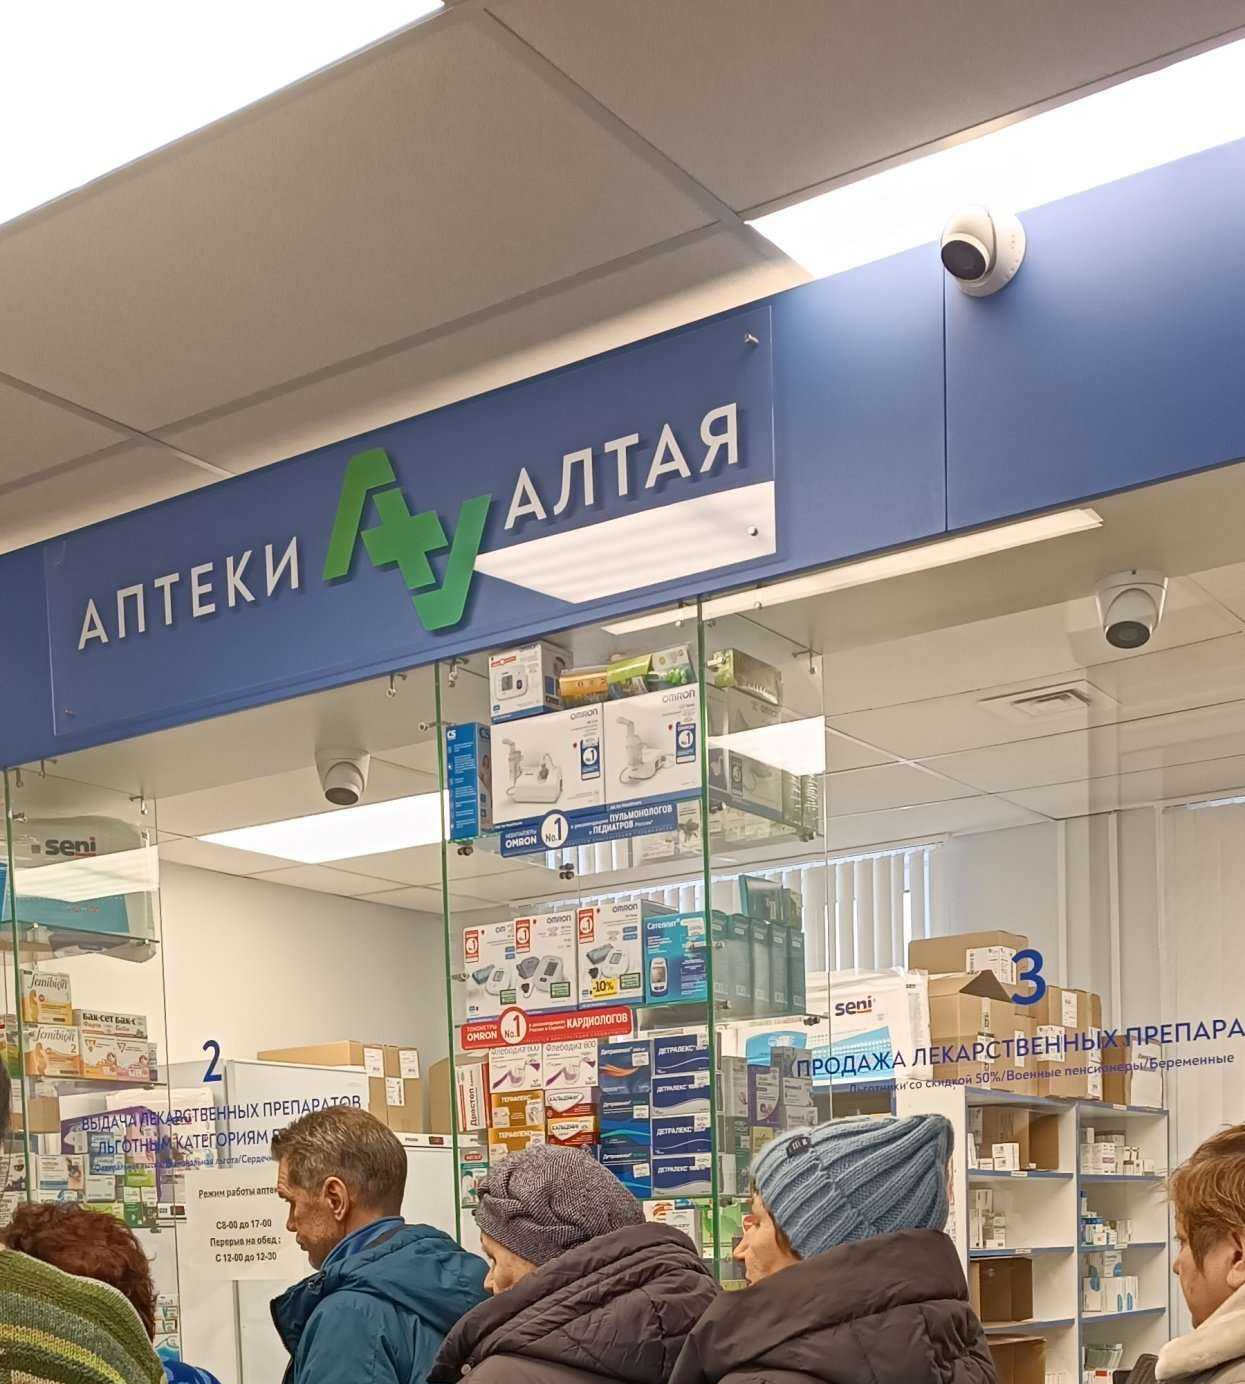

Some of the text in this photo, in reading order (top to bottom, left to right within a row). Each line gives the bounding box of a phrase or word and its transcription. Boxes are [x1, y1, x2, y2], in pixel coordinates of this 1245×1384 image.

[77, 402, 740, 651] АПТЕКИ АЛТАЯ
[609, 804, 673, 823] ПУЛЬМОНОЛОГОВ
[593, 820, 634, 835] ПЕДИАТРОВ
[45, 836, 97, 857] seni
[505, 835, 537, 849] OMRON
[1011, 949, 1047, 1006] 3
[593, 980, 614, 992] -10%
[835, 995, 873, 1017] seni
[567, 1012, 628, 1029] КАРДИОЛОГОВ
[467, 1031, 498, 1042] OMRON
[71, 1043, 77, 1053] 2
[797, 1050, 906, 1078] ПРОДАЖА
[912, 1029, 1118, 1067] ЛЕКАРСТВЕННЫХ
[202, 1039, 222, 1082] 2
[926, 1076, 972, 1089] скидкой
[82, 1095, 361, 1132] ВЫДАЧА ЛЕКАРСТВЕННЫХ ПРЕПАРАТОВ
[98, 1136, 172, 1154] ЛЬГОТНЫМ
[176, 1130, 269, 1151] КАТЕГОРИЯМ
[198, 1189, 225, 1199] Режим
[226, 1187, 255, 1198] работы
[239, 1221, 250, 1230] до
[251, 1219, 272, 1229] 17-00
[210, 1237, 245, 1248] Перерыв
[223, 1253, 244, 1263] 12-00
[244, 1254, 255, 1263] до
[257, 1252, 277, 1262] 12-30
